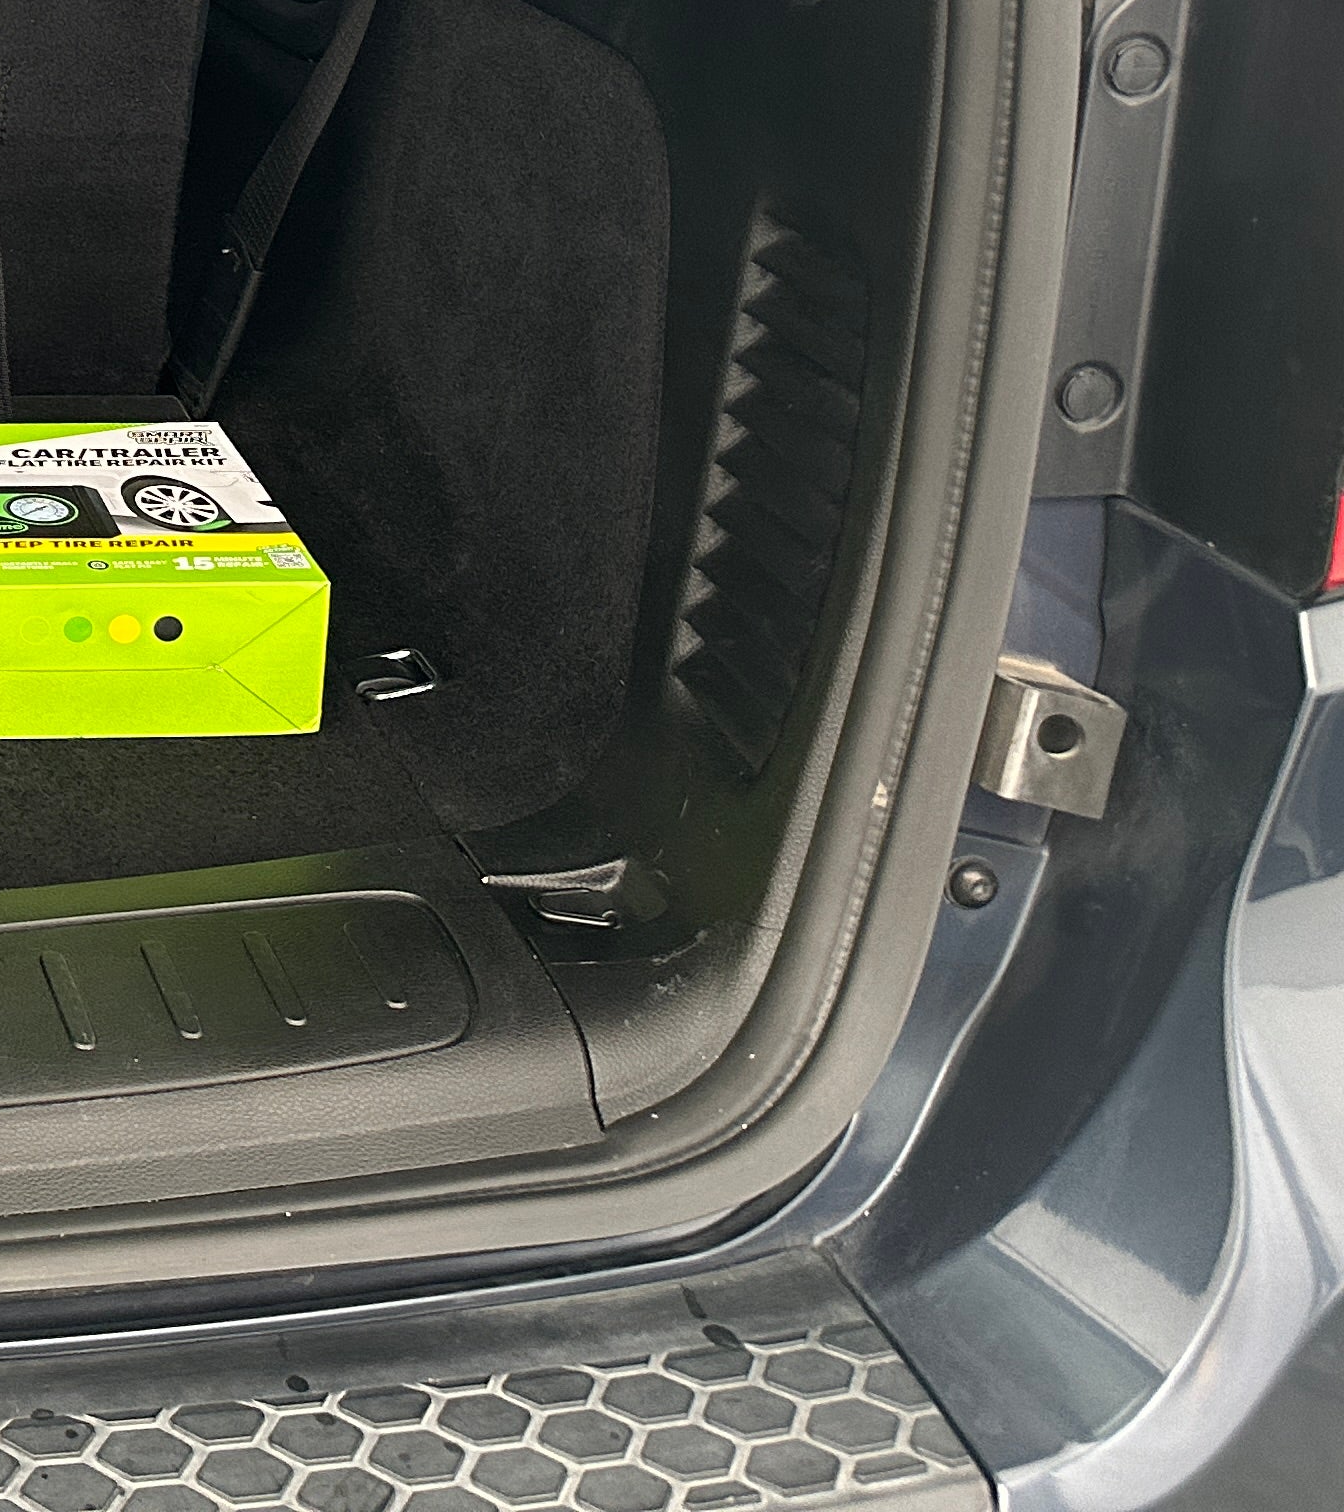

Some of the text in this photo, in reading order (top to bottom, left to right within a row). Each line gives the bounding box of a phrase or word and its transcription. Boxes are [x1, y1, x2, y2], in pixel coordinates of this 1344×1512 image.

[11, 448, 222, 460] CAR/TRAILER
[52, 459, 102, 467] TIRE
[106, 458, 188, 467] REPAIR
[190, 457, 228, 466] KIT
[52, 540, 102, 549] TIRE
[108, 539, 195, 548] REPAIR
[172, 556, 215, 571] 15
